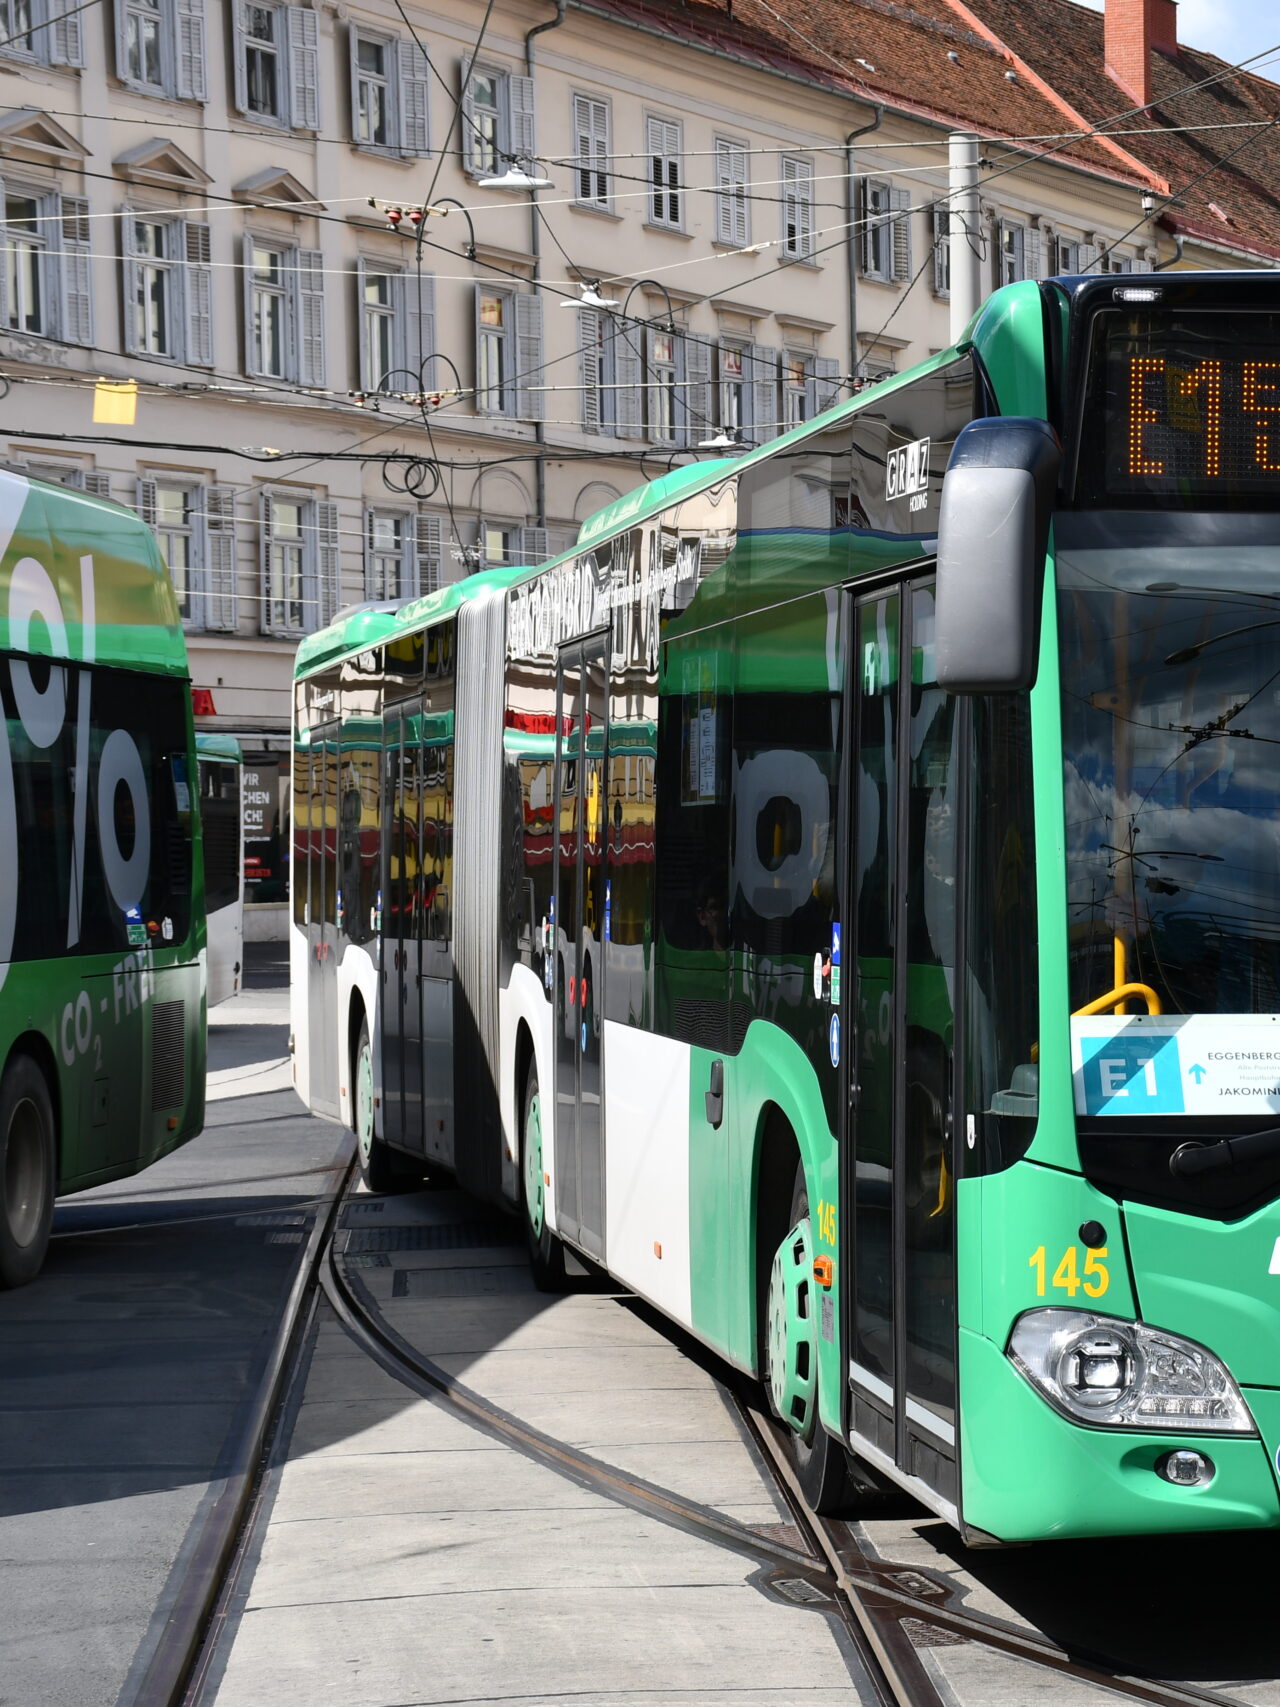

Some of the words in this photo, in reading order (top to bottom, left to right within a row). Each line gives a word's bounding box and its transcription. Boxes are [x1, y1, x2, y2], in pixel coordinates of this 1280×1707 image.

[1130, 358, 1220, 475] E1
[887, 439, 929, 498] GRAZ
[909, 493, 928, 512] HOLDING
[243, 792, 270, 804] CHEN
[245, 810, 263, 822] CH!
[113, 938, 155, 1024] FREI
[1099, 1058, 1158, 1097] E1
[817, 1199, 836, 1247] 145
[1028, 1245, 1110, 1298] 145
